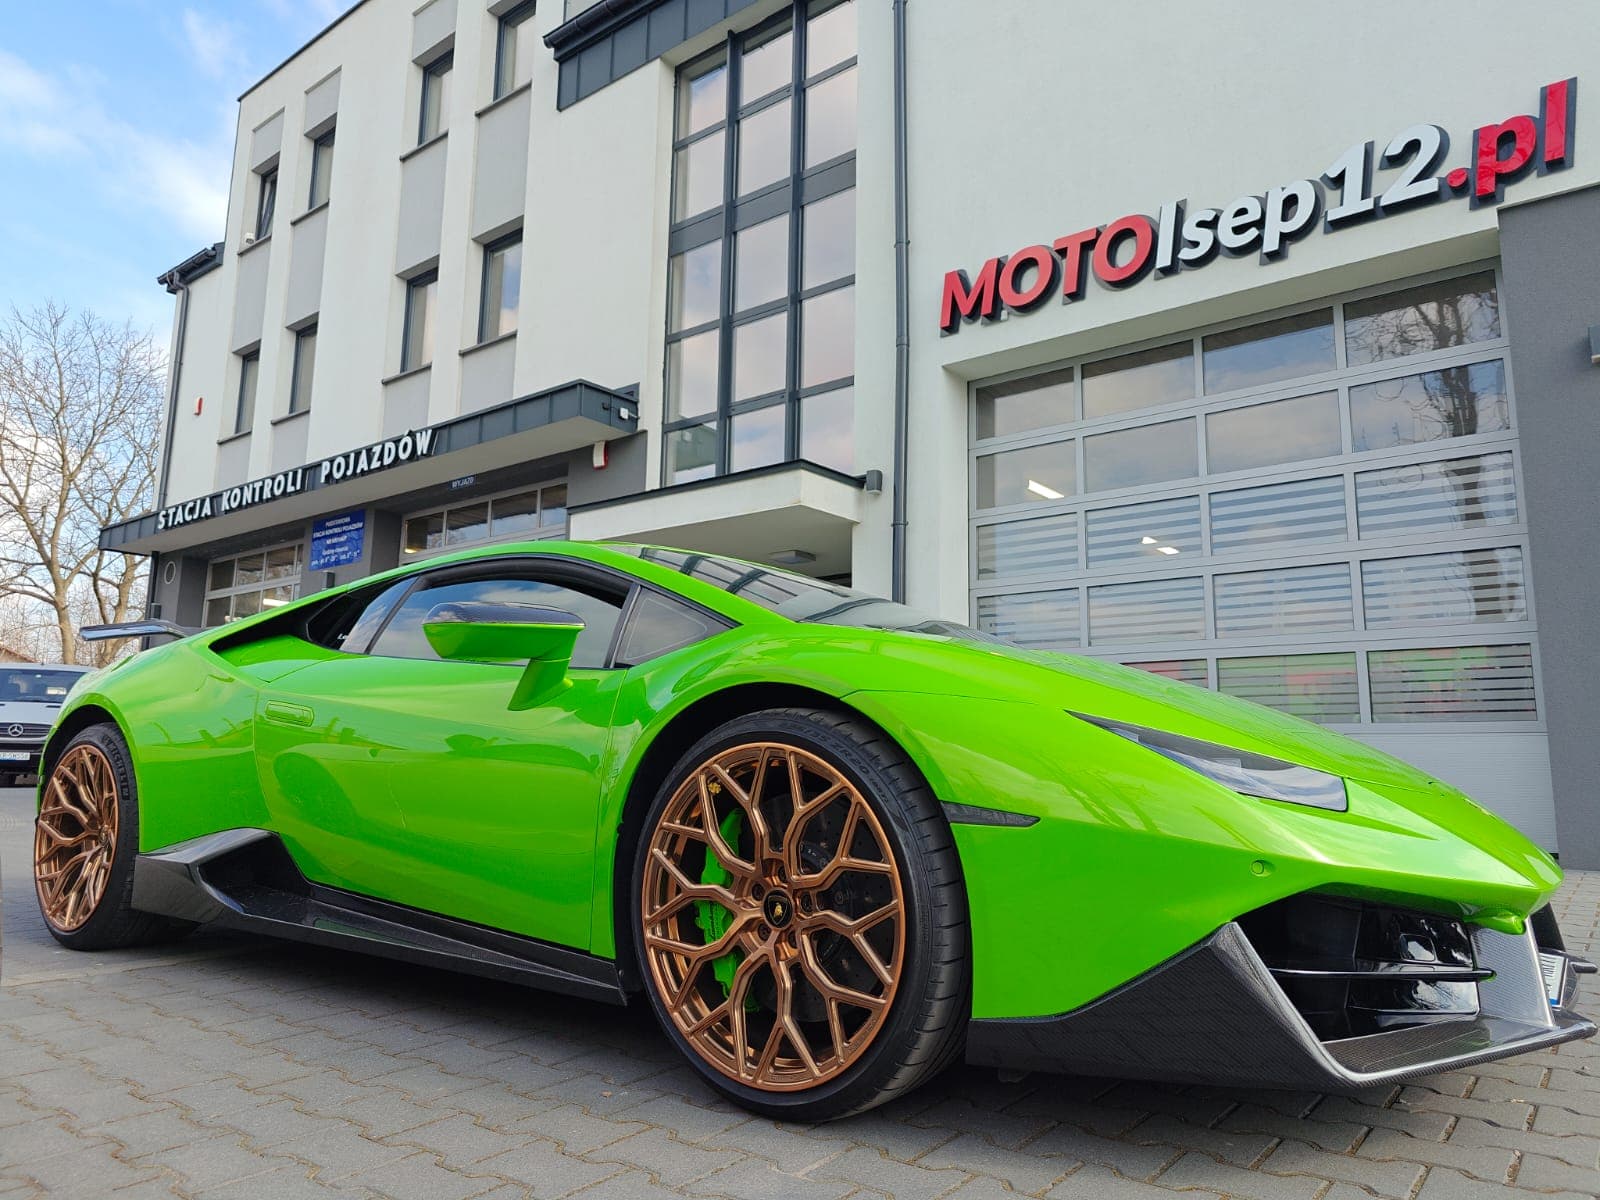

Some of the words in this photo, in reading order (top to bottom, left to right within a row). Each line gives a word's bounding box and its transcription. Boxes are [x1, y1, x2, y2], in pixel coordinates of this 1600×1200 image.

[157, 498, 212, 530] STACJA
[221, 469, 303, 512] KONTROLI
[320, 430, 433, 483] POJAZDÓW
